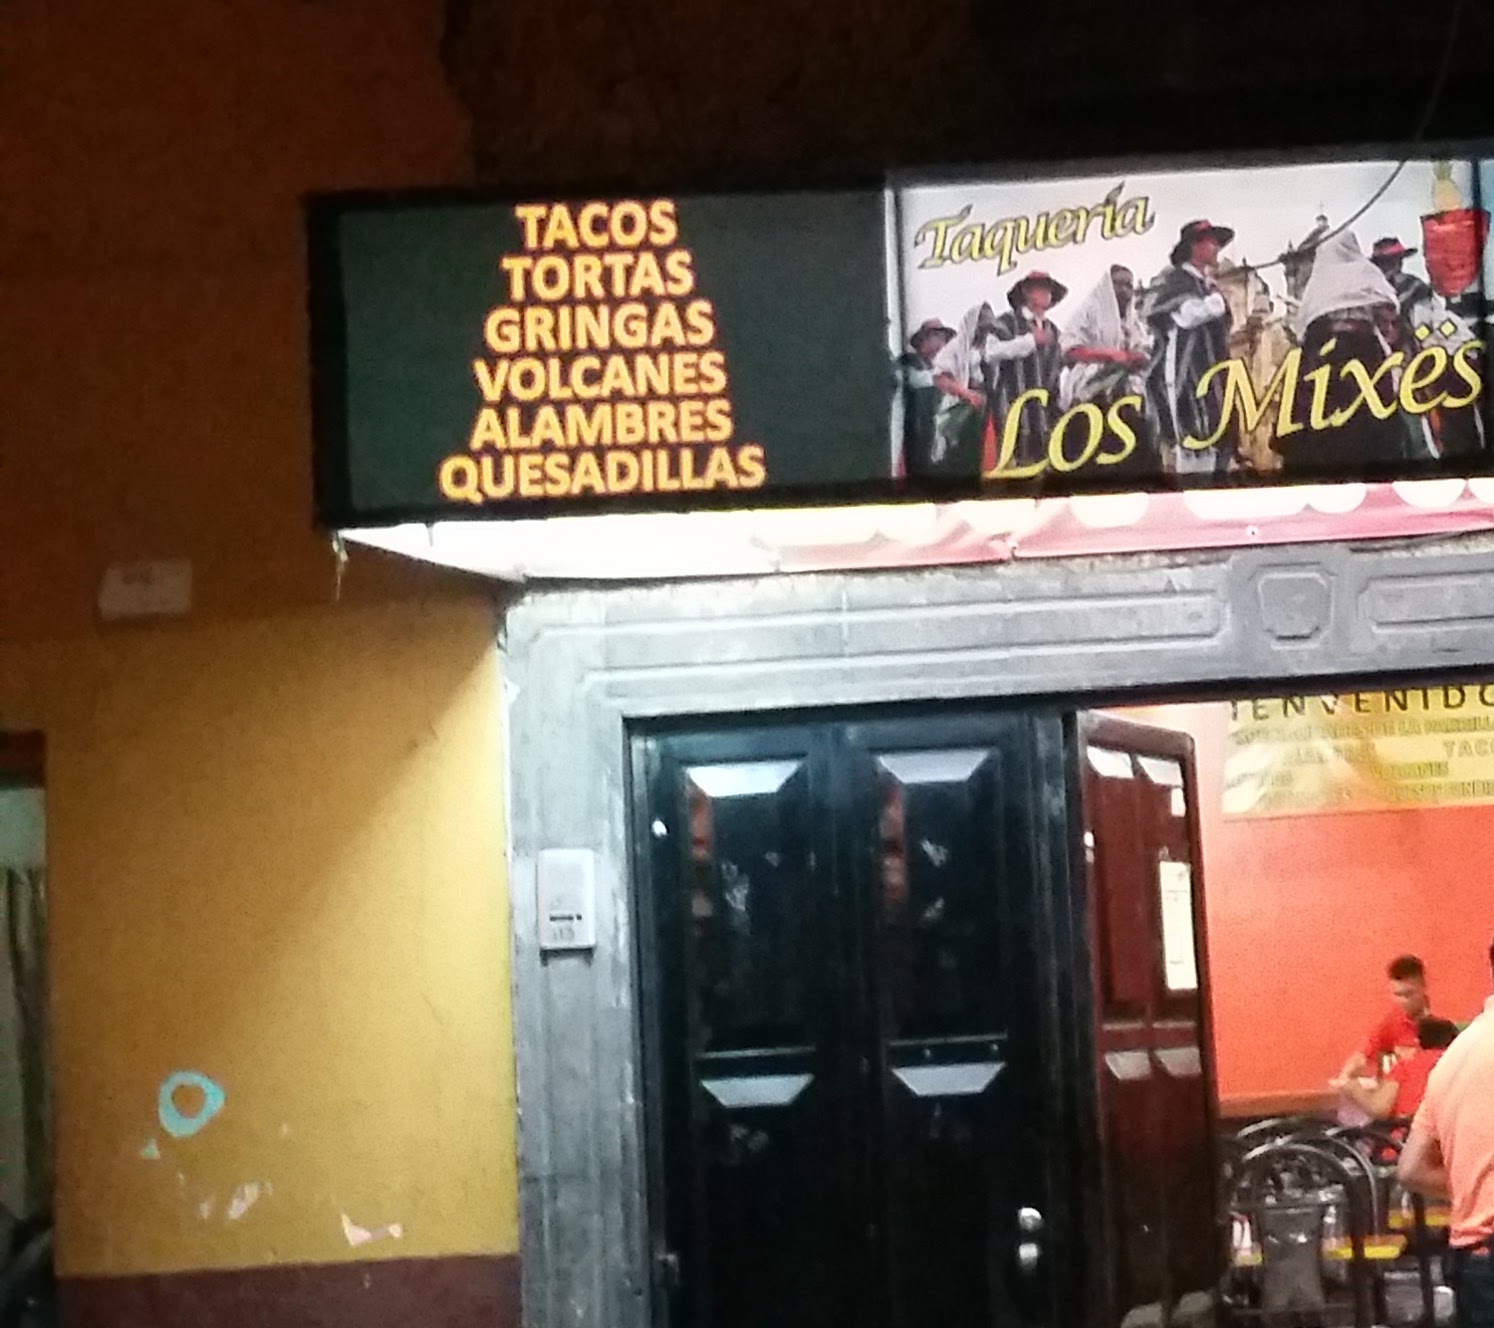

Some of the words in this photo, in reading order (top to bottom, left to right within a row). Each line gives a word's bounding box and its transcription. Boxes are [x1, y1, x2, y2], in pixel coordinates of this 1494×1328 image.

[515, 199, 678, 250] TACOS
[915, 180, 1155, 275] Taquería
[501, 249, 694, 302] TORTAS
[483, 299, 715, 353] GRINGAS
[473, 351, 727, 402] VOLCANES
[469, 399, 734, 451] ALAMBRES
[987, 388, 1142, 479] Los
[440, 445, 767, 504] QUESADILLAS
